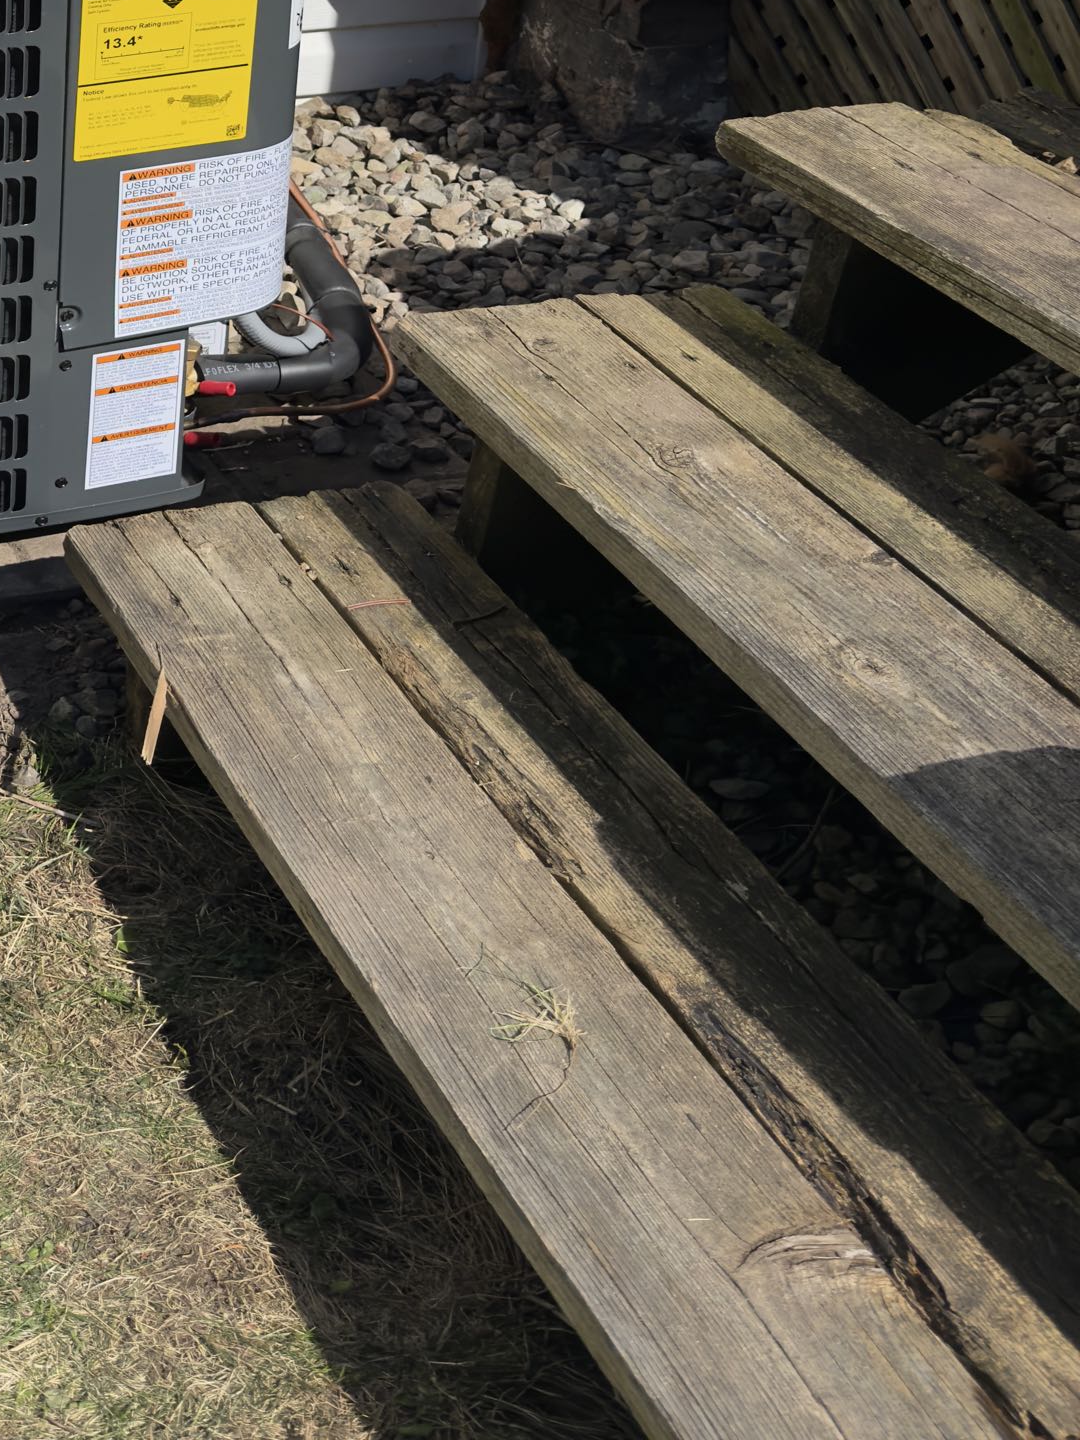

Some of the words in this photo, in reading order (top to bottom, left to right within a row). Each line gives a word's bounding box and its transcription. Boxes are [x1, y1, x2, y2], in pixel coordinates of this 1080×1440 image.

[103, 24, 137, 33] Efficiency
[139, 21, 162, 30] Rating
[138, 164, 191, 179] WARNING
[199, 160, 224, 170] RISK
[227, 157, 241, 166] OF
[245, 152, 266, 163] FIRE
[163, 176, 178, 184] TO
[182, 173, 195, 182] BE
[200, 164, 253, 178] REPAIRED
[257, 157, 279, 169] ONLY
[199, 178, 215, 187] DO
[218, 174, 241, 183] NOT
[122, 229, 136, 237] OF
[140, 218, 200, 233] PROPERLY
[203, 215, 213, 223] IN
[217, 200, 281, 221] ACCORDANCE
[135, 211, 189, 225] WARNING
[195, 206, 219, 216] RISK
[222, 203, 238, 213] OF
[240, 199, 262, 209] FIRE
[122, 238, 187, 254] FLAMMABLE
[191, 223, 264, 242] REFRIGERANT
[177, 228, 193, 236] OR
[197, 221, 231, 233] LOCAL
[122, 277, 136, 286] BE
[140, 270, 188, 282] IGNITION
[191, 259, 243, 274] SOURCES
[246, 251, 272, 264] SHALL
[131, 260, 185, 274] WARNING
[193, 255, 217, 265] RISK
[221, 252, 235, 261] OF
[239, 246, 260, 257] FIRE
[192, 269, 229, 281] OTHER
[232, 263, 258, 274] THAN
[122, 292, 143, 303] USE
[147, 287, 175, 298] WITH
[179, 283, 200, 293] THE
[203, 274, 250, 289] SPECIFIC
[128, 347, 163, 358] WARNING
[119, 378, 168, 390] ADVERTENCIA
[110, 424, 168, 438] AVERTISSEMENT
